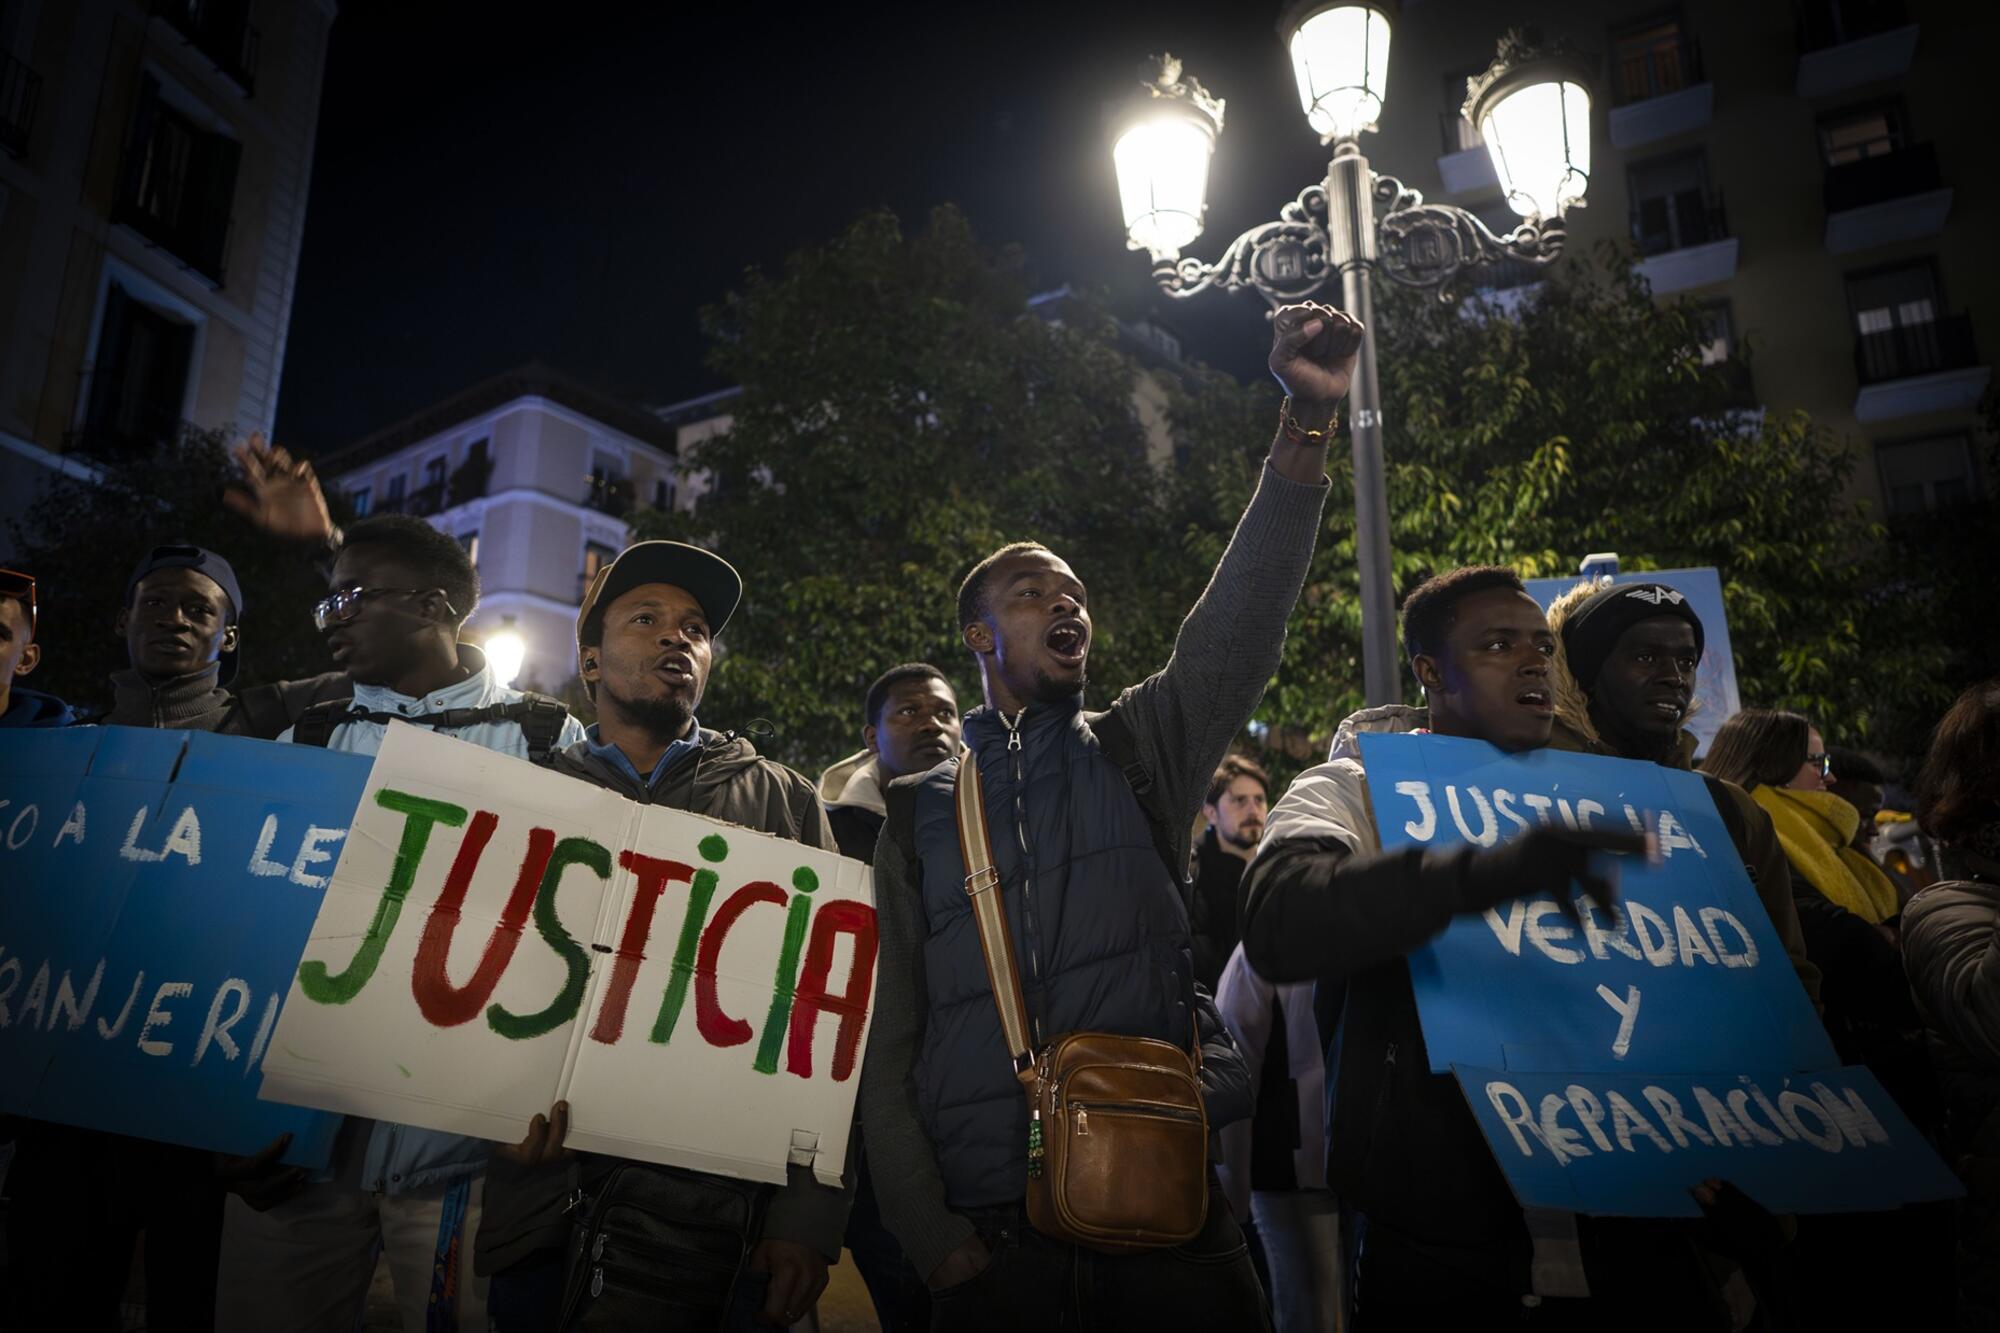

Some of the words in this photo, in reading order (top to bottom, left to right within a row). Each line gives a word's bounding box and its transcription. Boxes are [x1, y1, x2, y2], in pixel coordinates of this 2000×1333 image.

[54, 800, 86, 848] A
[120, 806, 201, 865] LA
[1482, 896, 1760, 968] VERDAD
[1596, 984, 1641, 1060] Y
